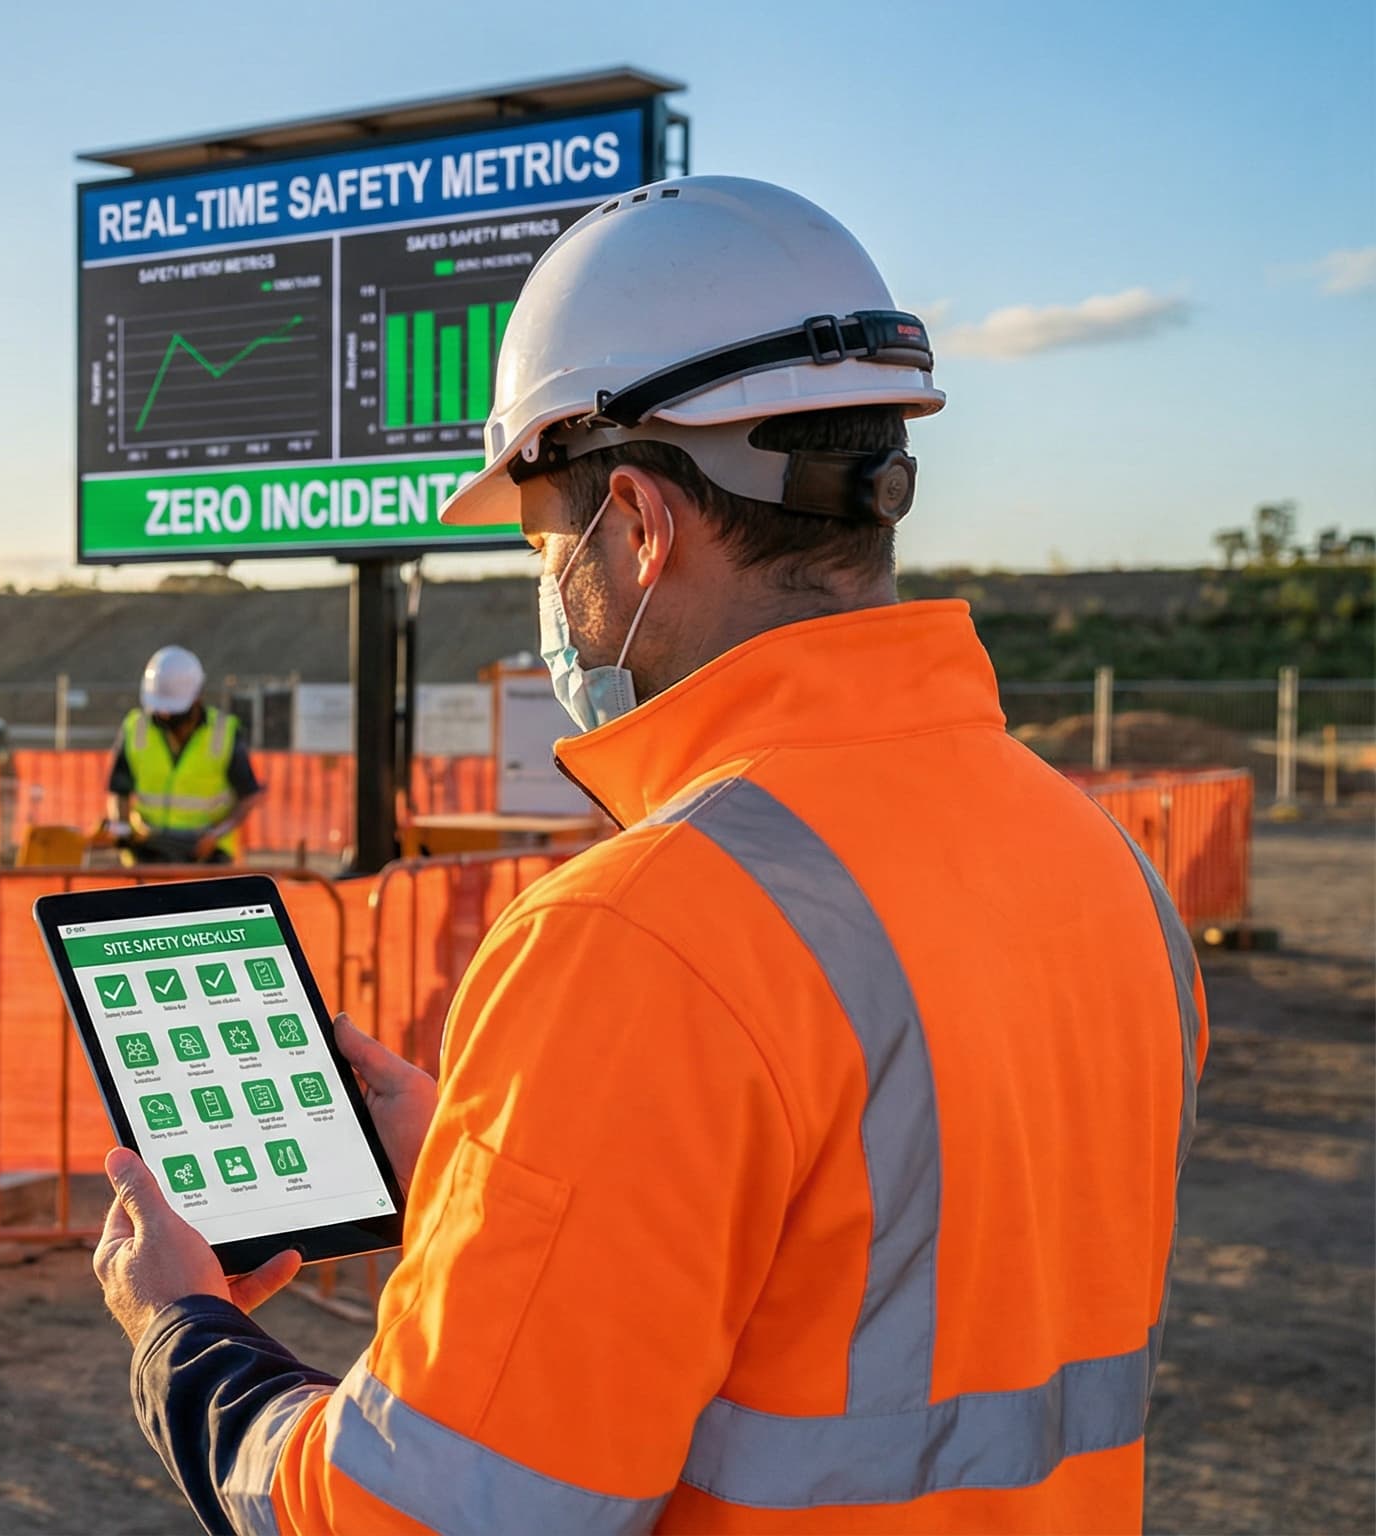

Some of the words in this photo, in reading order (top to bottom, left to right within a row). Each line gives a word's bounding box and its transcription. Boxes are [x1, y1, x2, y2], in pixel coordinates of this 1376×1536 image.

[99, 181, 279, 244] REAL-TIME
[287, 159, 432, 220] SAFETY
[441, 131, 621, 199] METRICS
[449, 226, 499, 248] SAFETY
[499, 218, 560, 241] METRICS
[138, 264, 180, 284] SAFETY
[144, 484, 252, 537] ZERO
[103, 940, 133, 956] SITE
[132, 934, 180, 952] SAFETY
